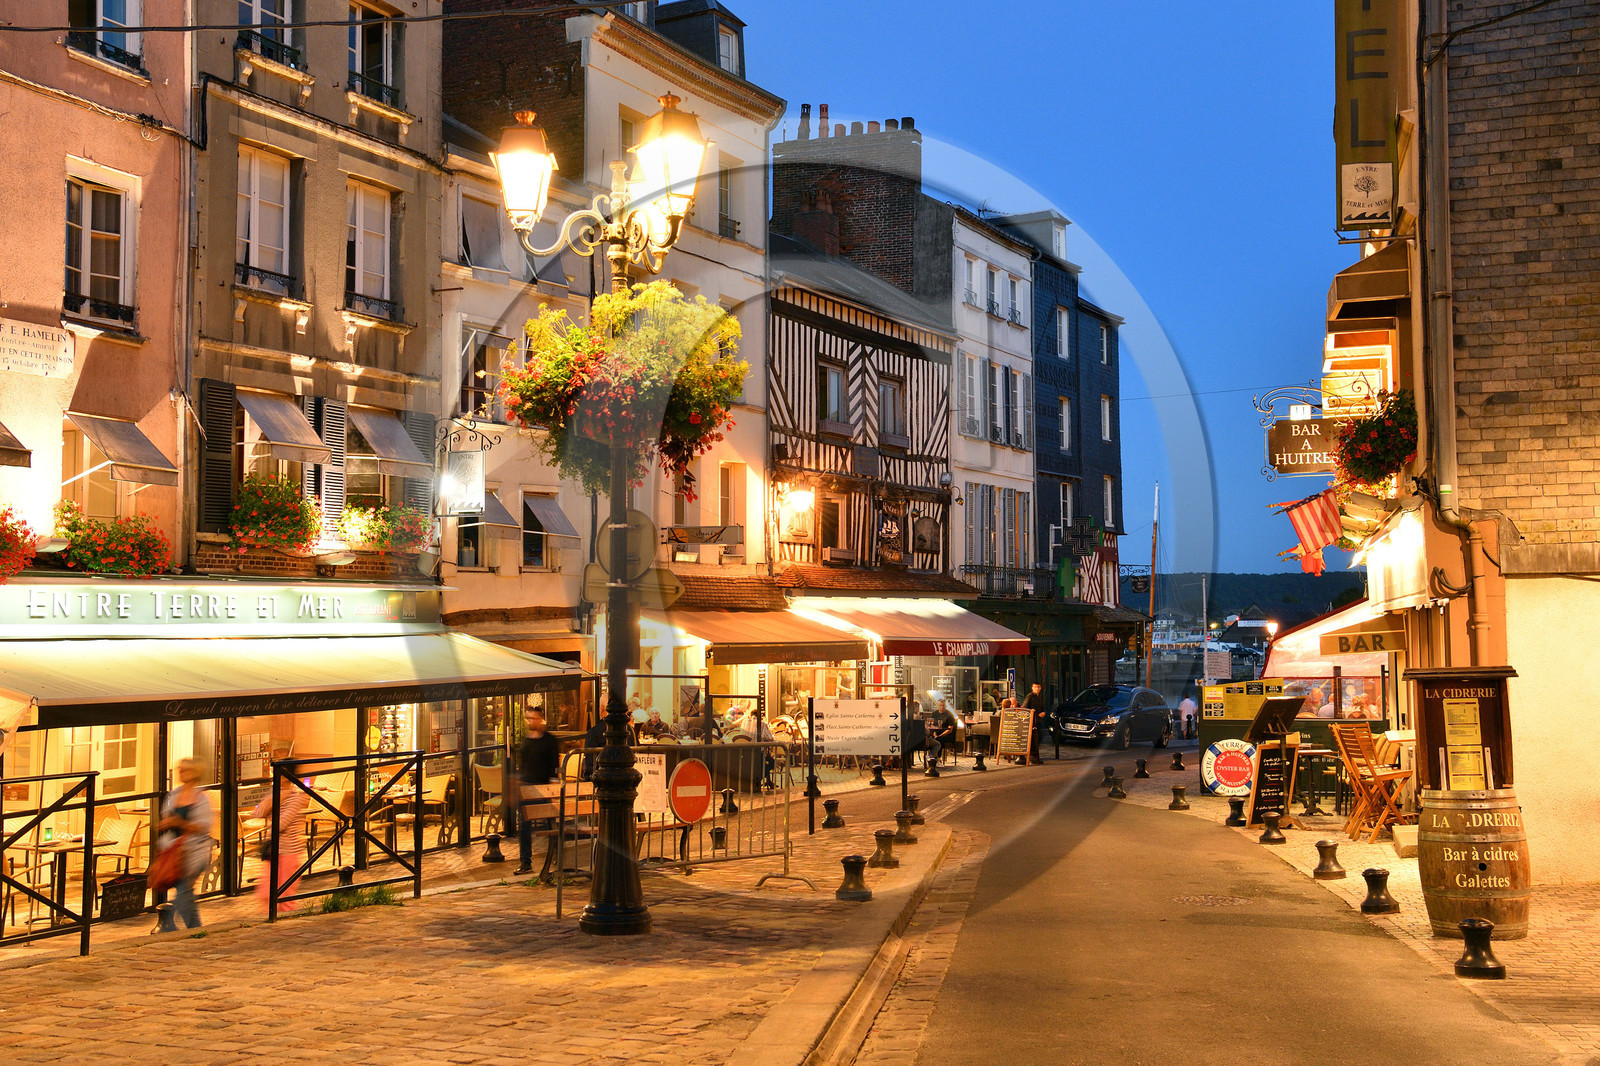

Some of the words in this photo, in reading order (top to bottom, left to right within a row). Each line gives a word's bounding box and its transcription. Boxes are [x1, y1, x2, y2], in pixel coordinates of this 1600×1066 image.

[1355, 166, 1380, 174] ENTRE
[1345, 200, 1366, 209] TERRE
[1374, 197, 1389, 207] MER
[23, 327, 67, 342] HAMELIN
[20, 350, 43, 360] CETTE
[46, 354, 73, 364] MAISON
[1291, 423, 1321, 436] BAR
[1301, 438, 1312, 450] A
[27, 589, 132, 619] ENTRE
[151, 591, 238, 619] TERRE
[257, 595, 280, 619] ET
[298, 594, 344, 619] MER
[932, 641, 943, 655] LE
[946, 642, 990, 656] CHAMPLAIN
[1338, 634, 1386, 653] BAR
[1425, 688, 1440, 699] LA
[1442, 687, 1496, 699] CIDRERIE
[163, 700, 187, 717] Le
[191, 701, 217, 714] seul
[219, 703, 260, 717] moyen
[265, 698, 279, 710] de
[1217, 755, 1226, 764] BAR
[1432, 814, 1451, 828] LA
[1443, 847, 1468, 861] Bar
[1471, 846, 1480, 861] à
[1483, 846, 1519, 861] cidres
[1455, 873, 1510, 888] Galettes
